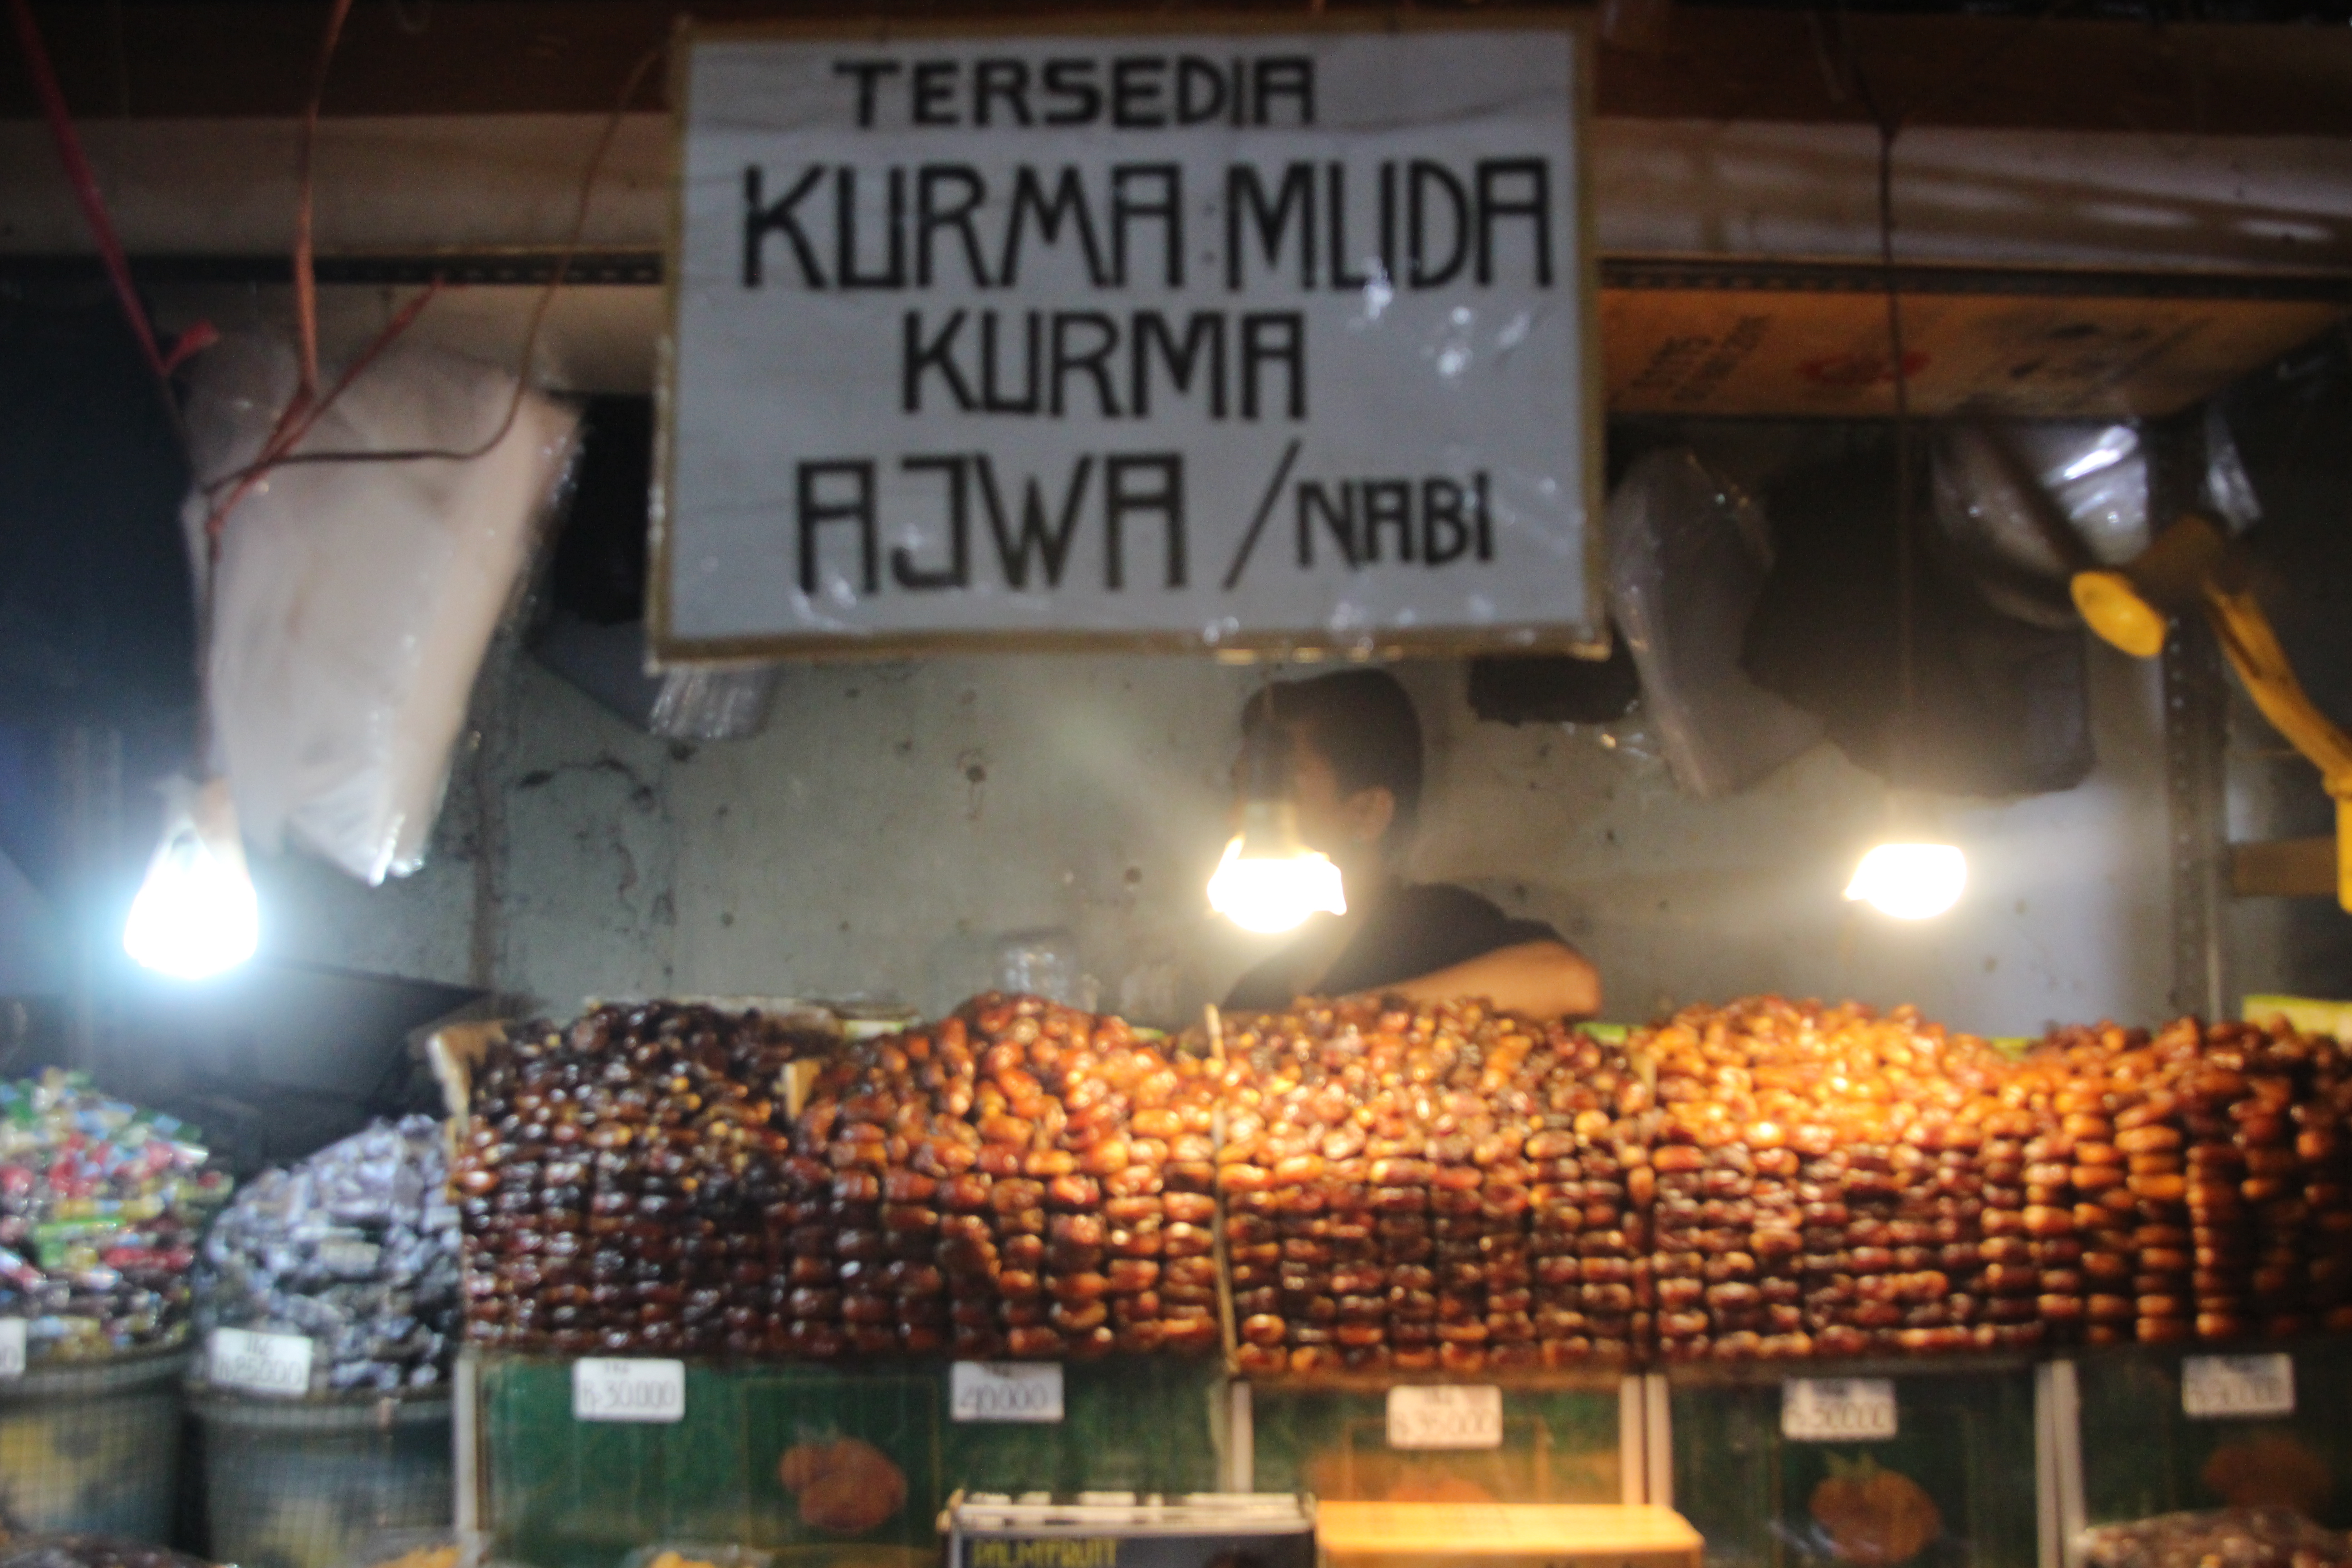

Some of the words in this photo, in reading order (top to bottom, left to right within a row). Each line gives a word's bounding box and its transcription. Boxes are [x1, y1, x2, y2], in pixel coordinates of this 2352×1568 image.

[832, 54, 1317, 131] TERSEDIA
[742, 159, 1184, 290] KURMA
[1225, 157, 1554, 291] MUDA
[902, 309, 1308, 421] KURMA
[795, 451, 1190, 595] AJWA
